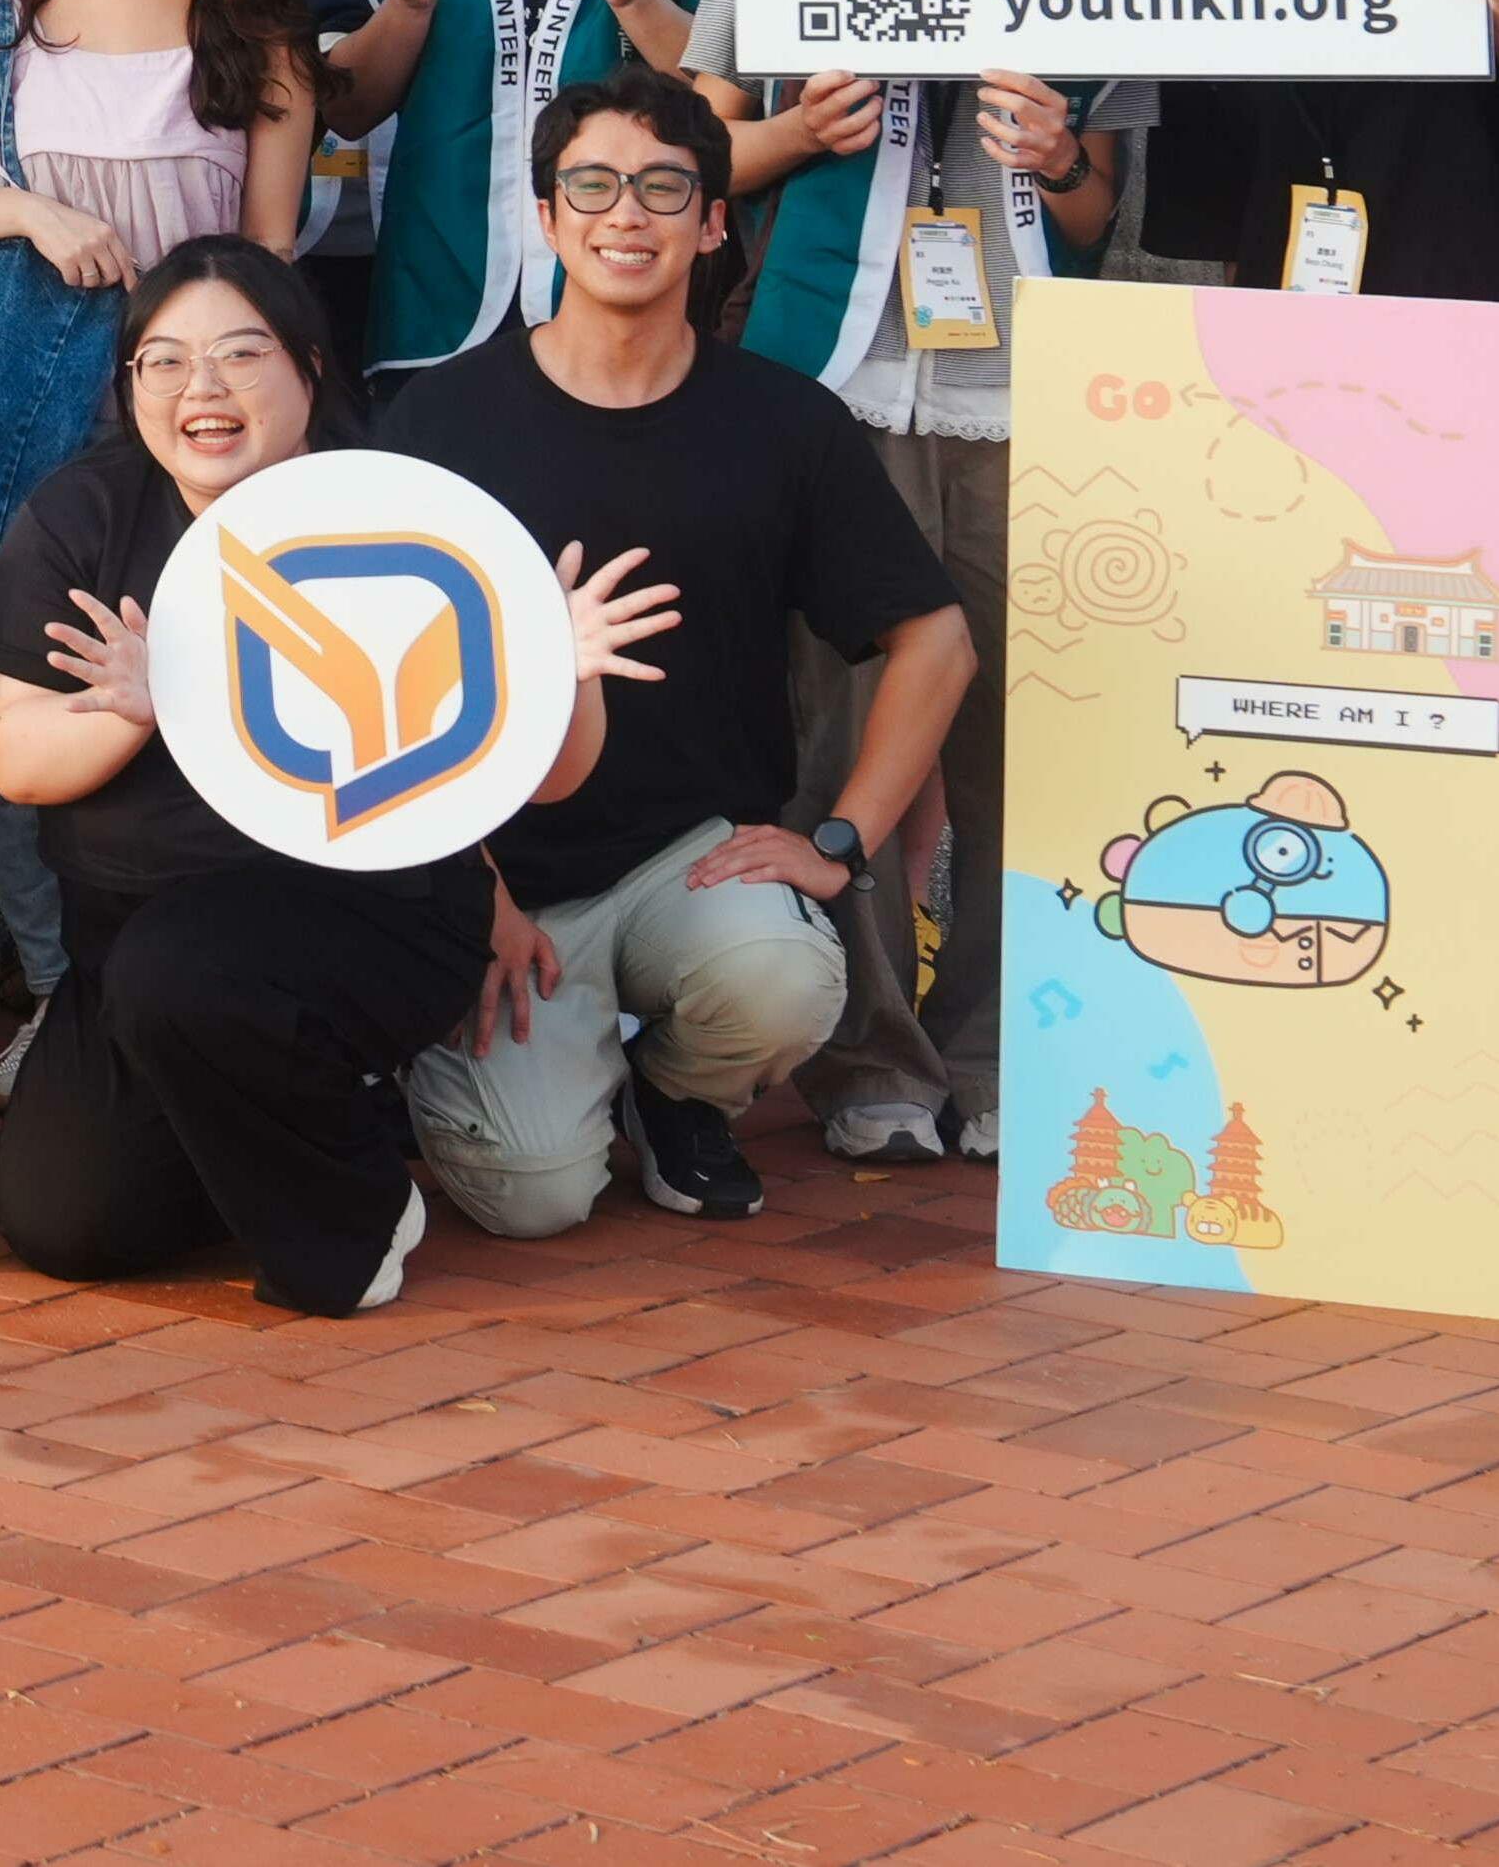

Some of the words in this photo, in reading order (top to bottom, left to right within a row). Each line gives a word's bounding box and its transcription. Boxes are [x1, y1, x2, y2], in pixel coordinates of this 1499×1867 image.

[1232, 697, 1320, 721] WHERE
[1339, 705, 1374, 724] AM
[1395, 710, 1410, 728] I
[1429, 714, 1446, 730] ?
